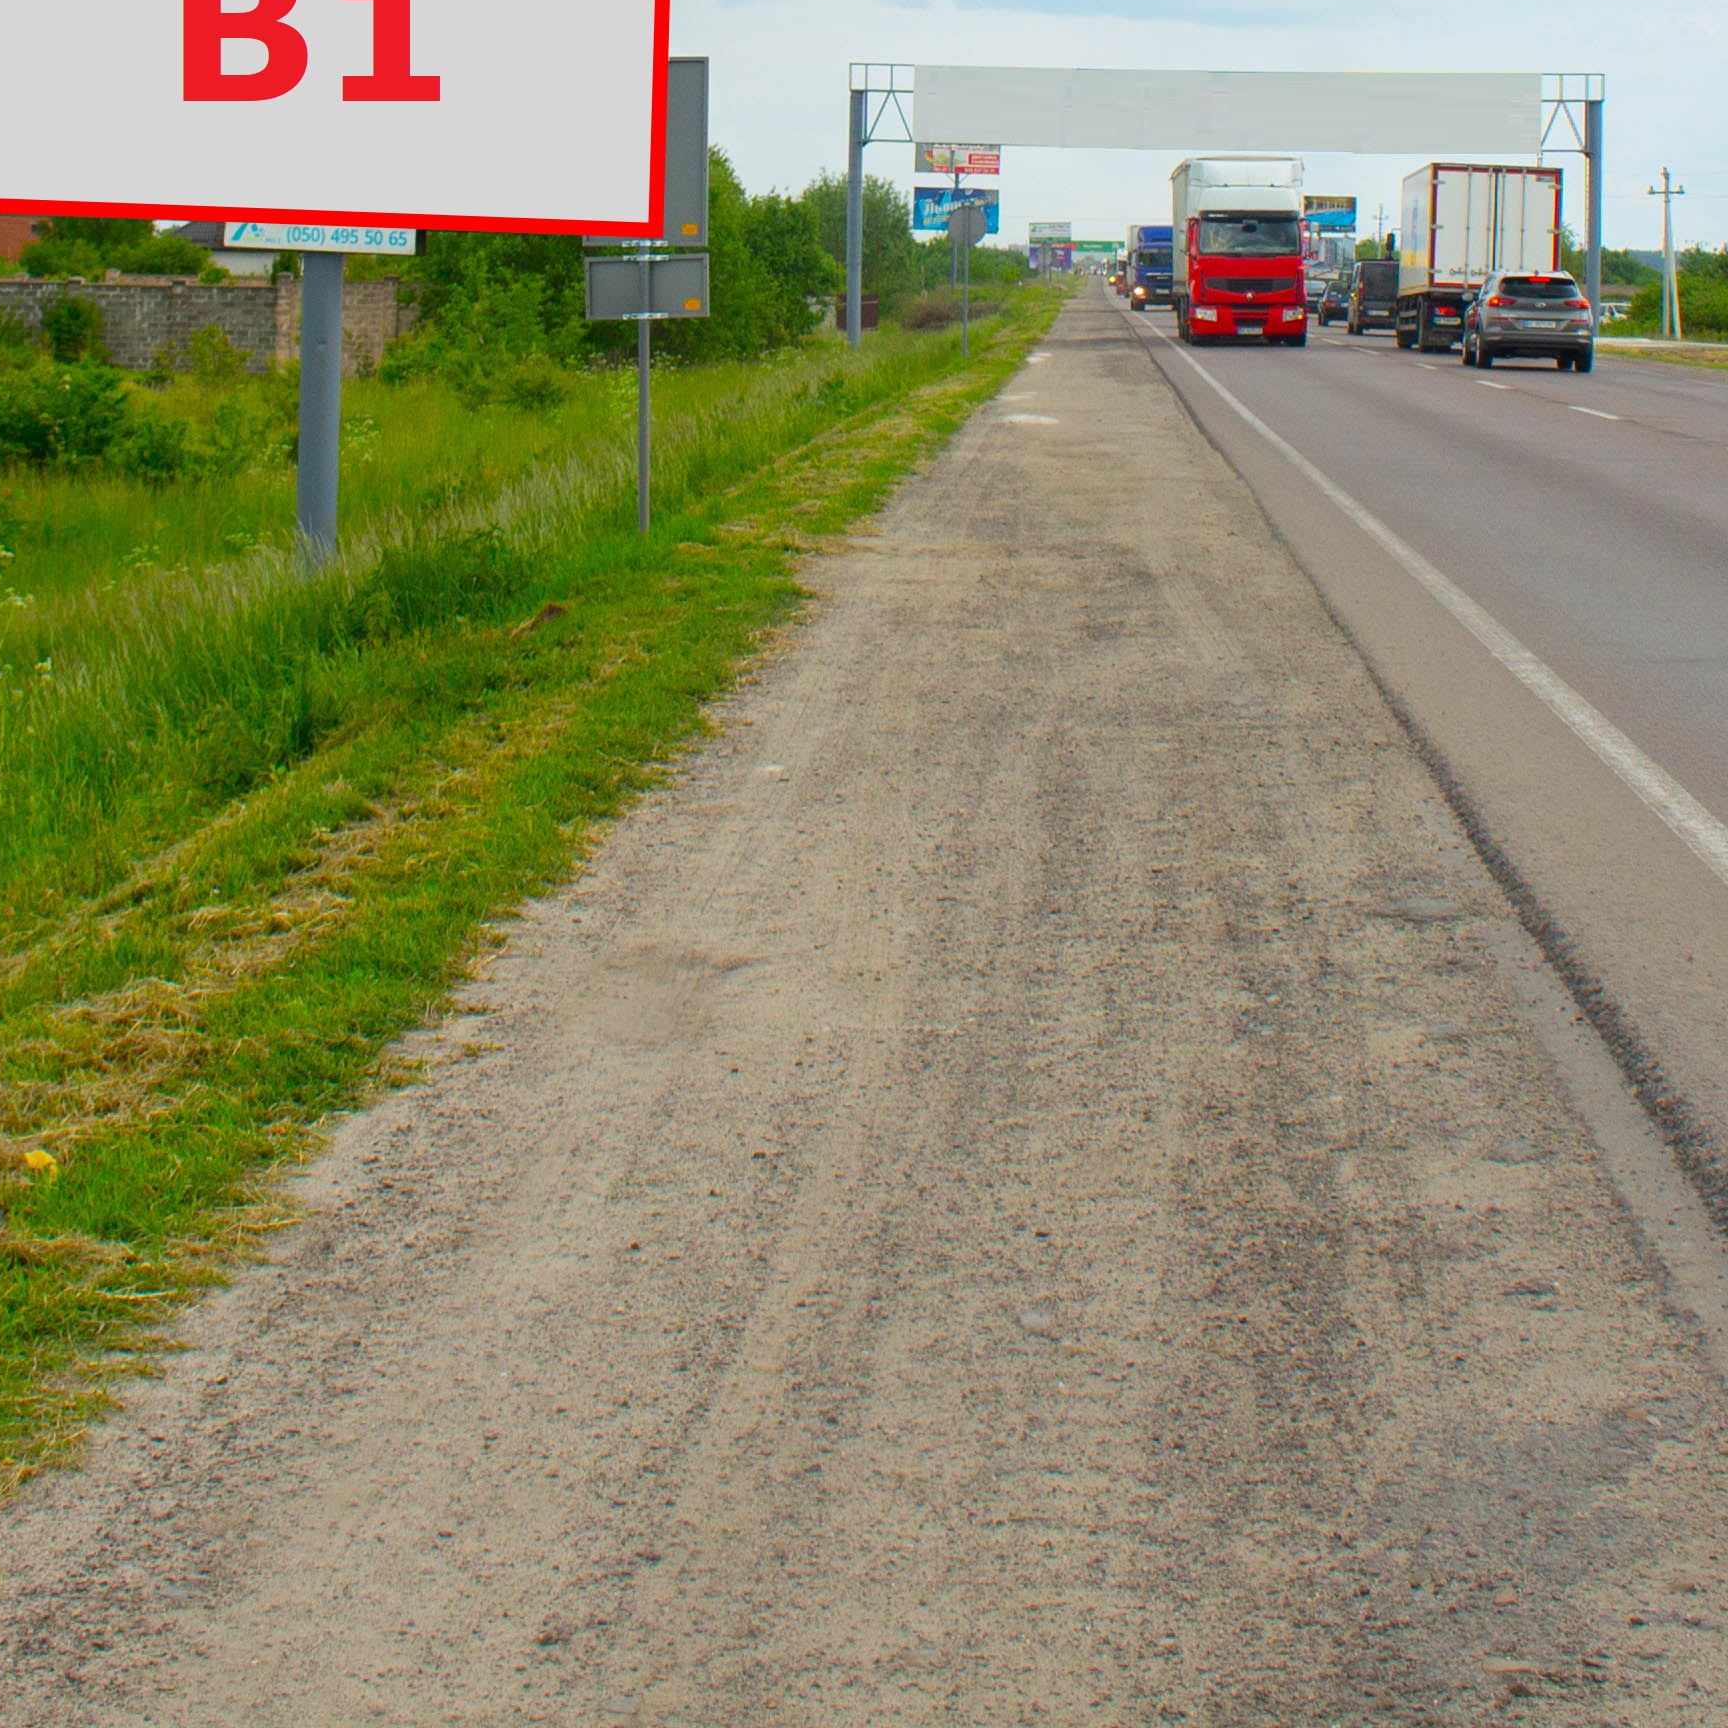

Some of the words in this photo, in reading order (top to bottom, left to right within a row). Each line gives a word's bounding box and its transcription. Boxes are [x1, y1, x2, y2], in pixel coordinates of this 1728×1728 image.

[286, 226, 326, 246] (050)
[330, 229, 359, 246] 495
[364, 231, 384, 246] 50
[388, 232, 408, 247] 65
